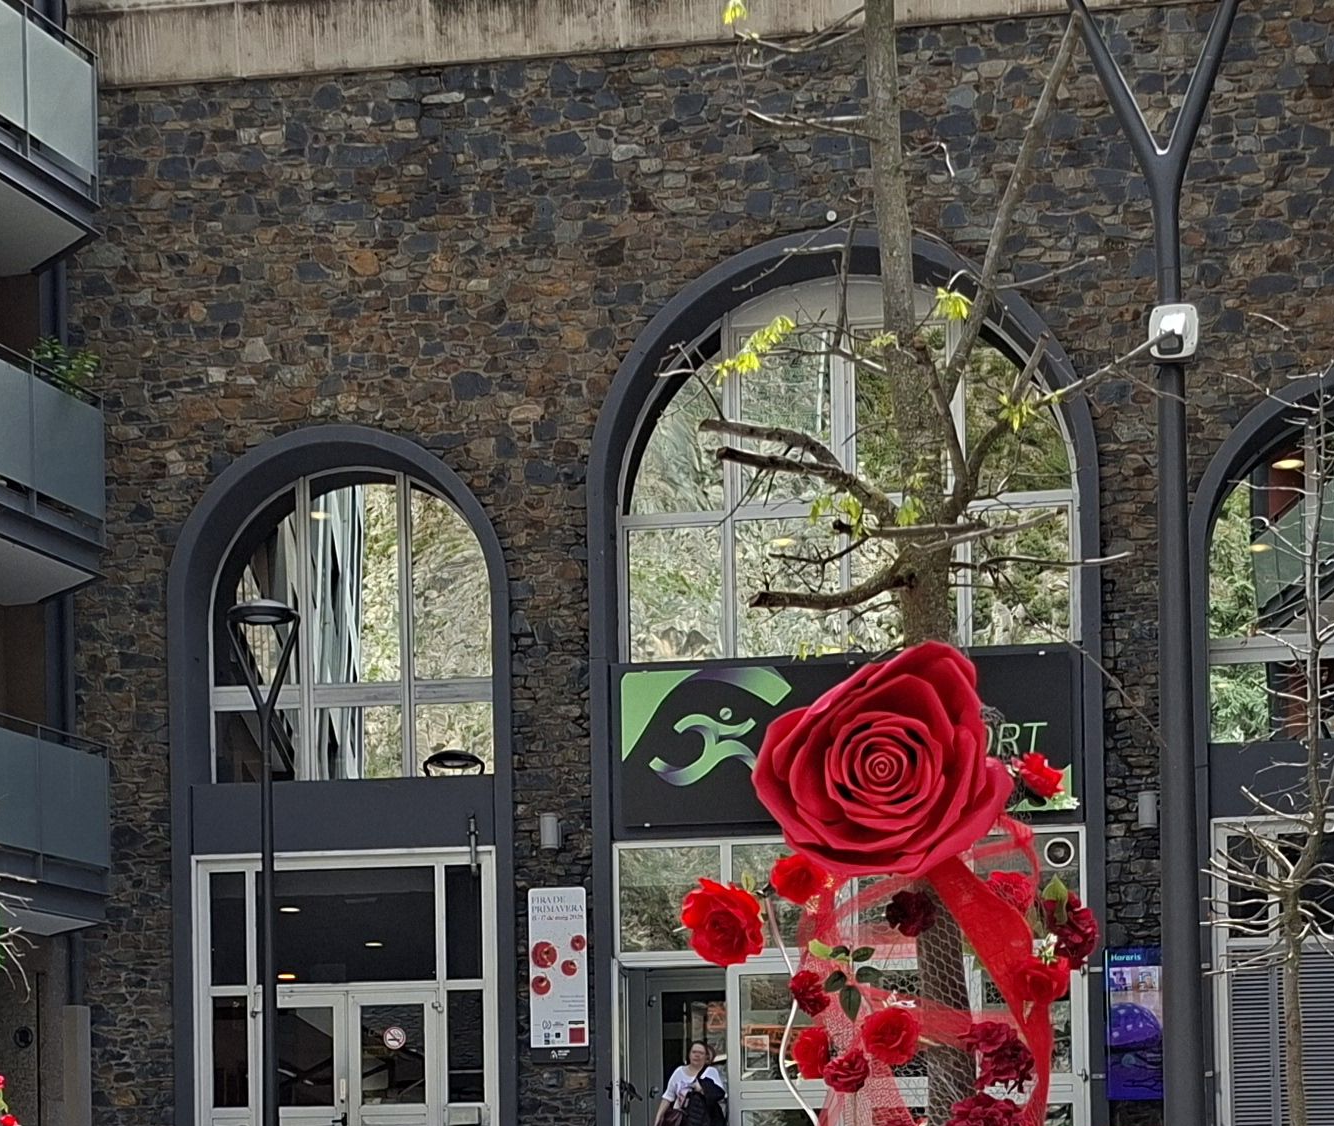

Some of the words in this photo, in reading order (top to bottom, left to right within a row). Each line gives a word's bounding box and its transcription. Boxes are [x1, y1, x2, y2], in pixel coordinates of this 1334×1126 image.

[531, 896, 552, 904] FIRA
[531, 904, 584, 913] PRIMAVERA
[1110, 953, 1142, 962] Horaris
